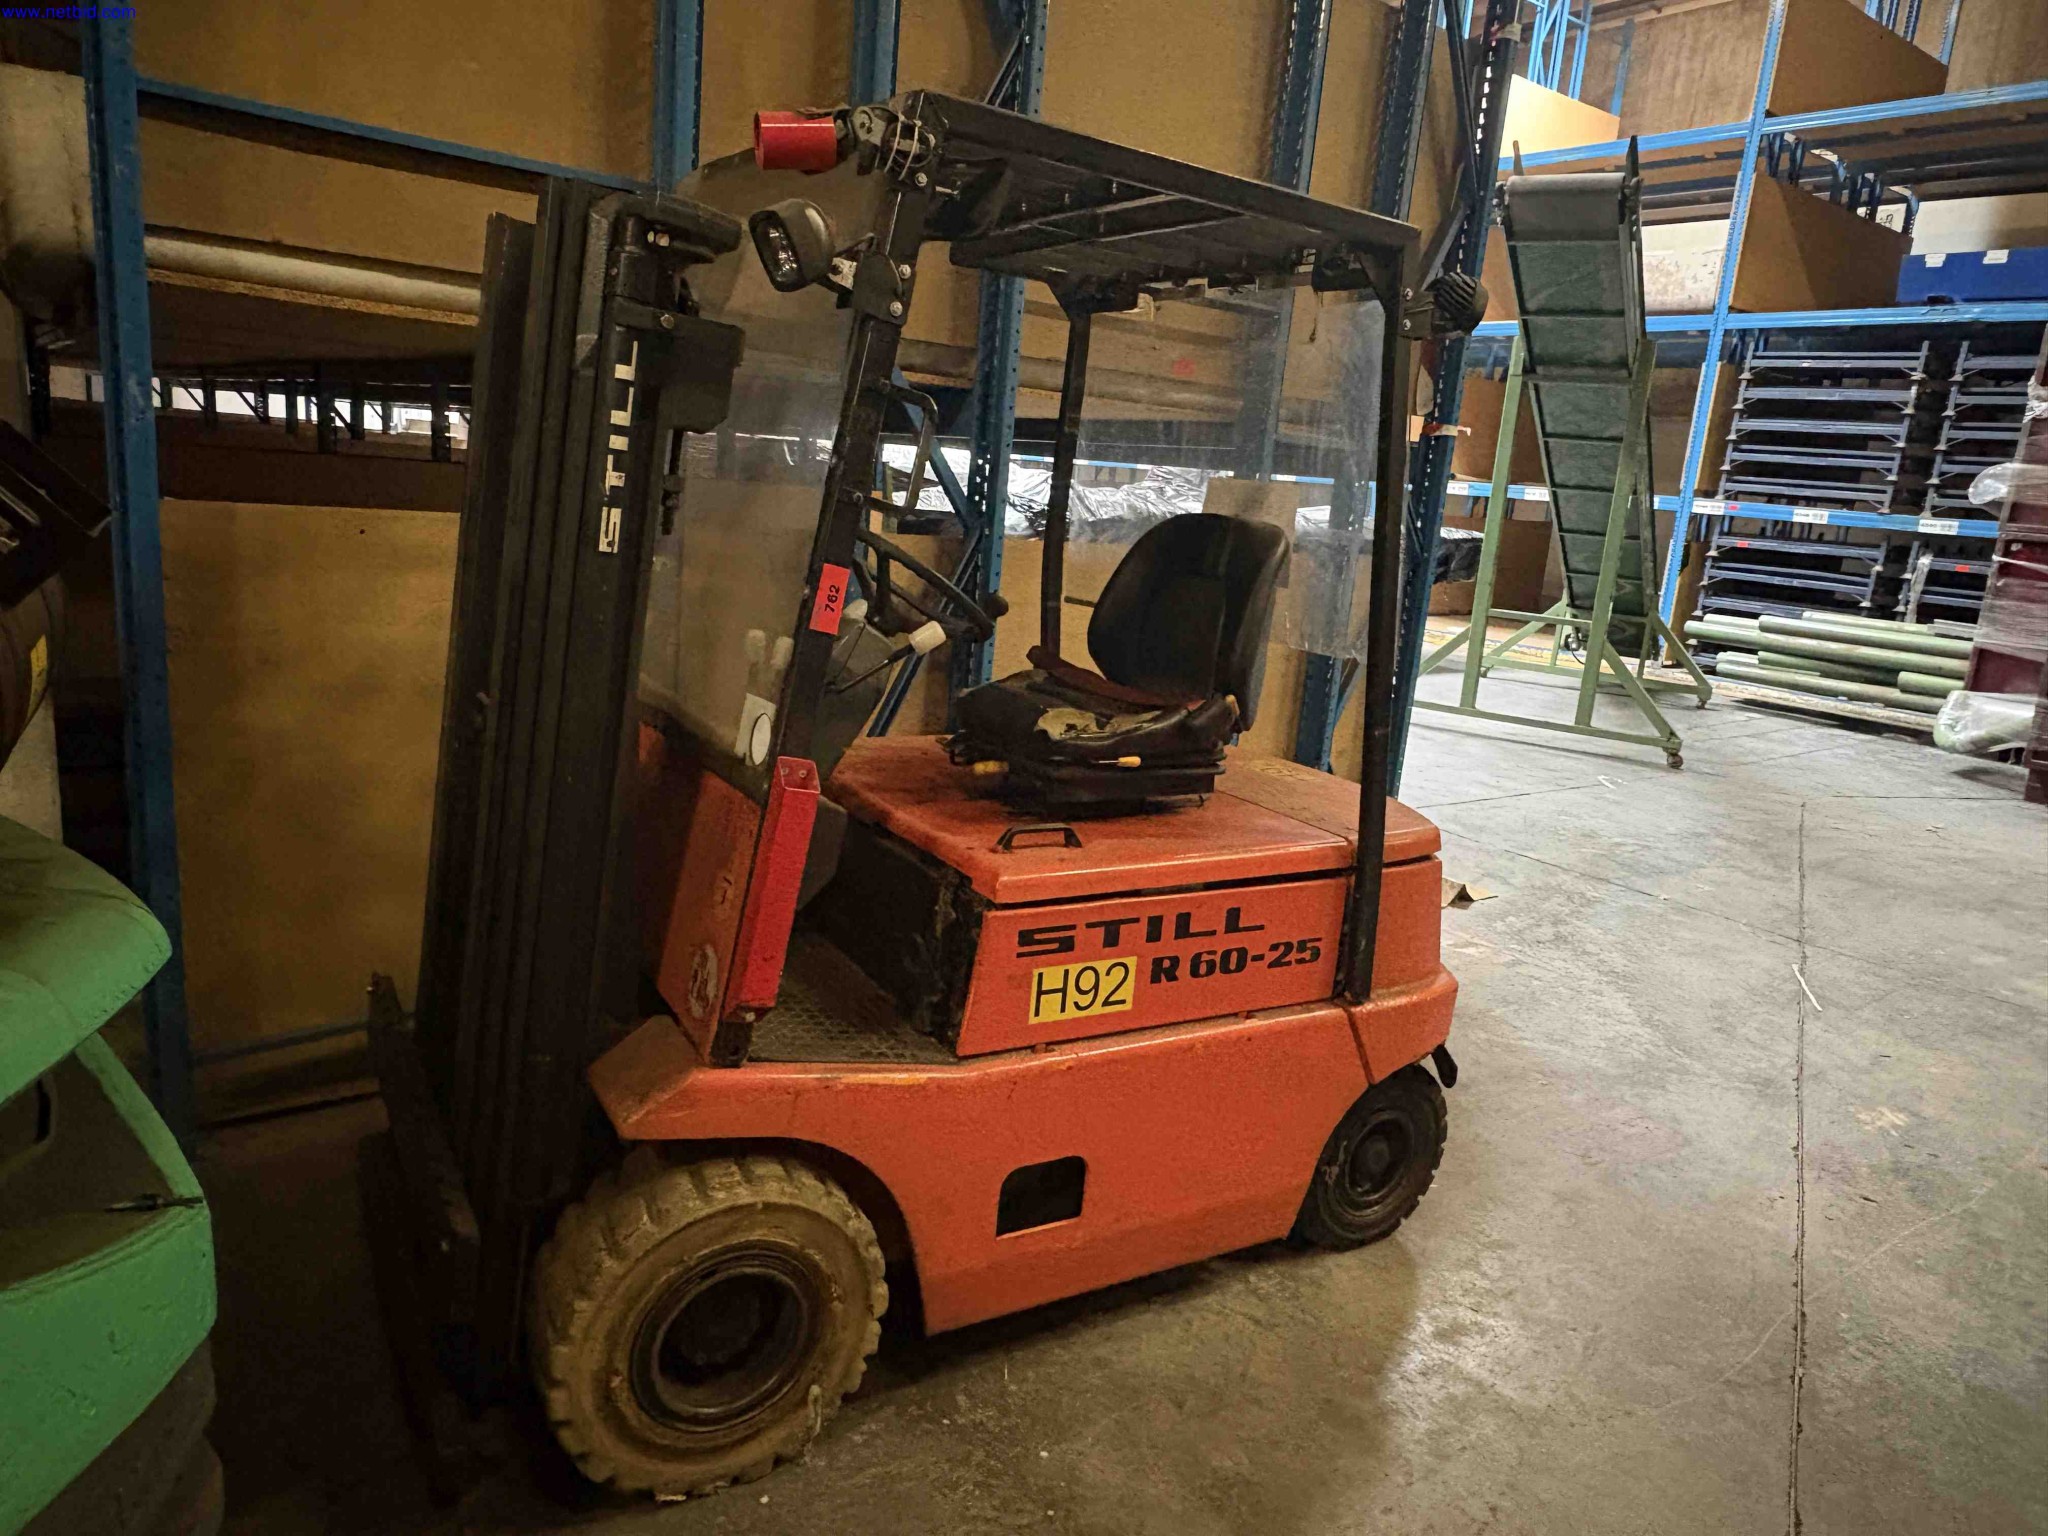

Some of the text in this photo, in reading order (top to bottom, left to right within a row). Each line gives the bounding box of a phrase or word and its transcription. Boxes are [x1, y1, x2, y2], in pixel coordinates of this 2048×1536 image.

[599, 340, 639, 554] STILL
[824, 584, 841, 613] 762
[1016, 906, 1265, 959] STILL
[1033, 960, 1131, 1018] H92
